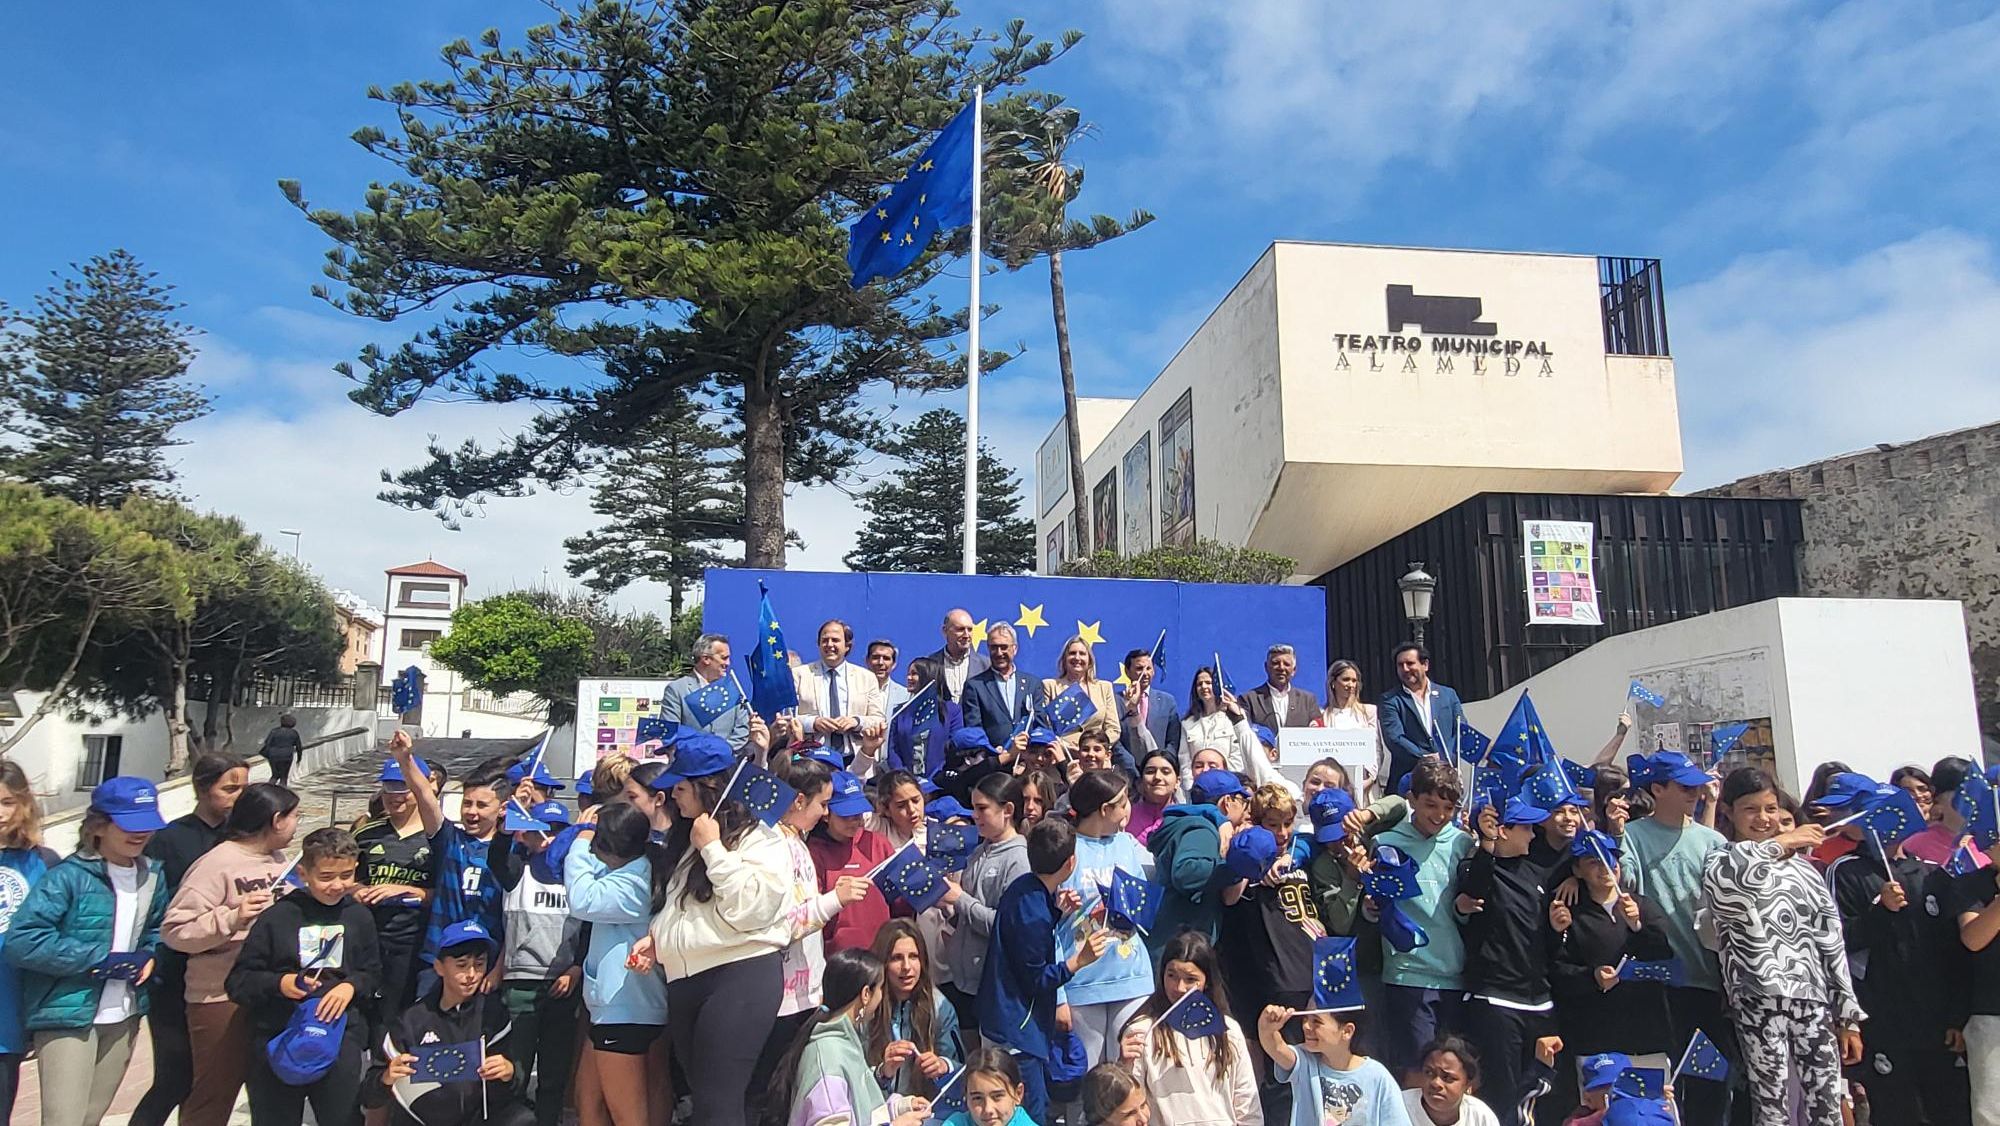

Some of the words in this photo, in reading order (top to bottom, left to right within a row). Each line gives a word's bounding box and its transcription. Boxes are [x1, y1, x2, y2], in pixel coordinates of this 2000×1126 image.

[1335, 333, 1422, 352] TEATRO
[1431, 337, 1554, 356] MUNICIPAL
[1335, 352, 1555, 377] ALAMEDA
[234, 876, 267, 895] New
[1279, 884, 1319, 923] 96
